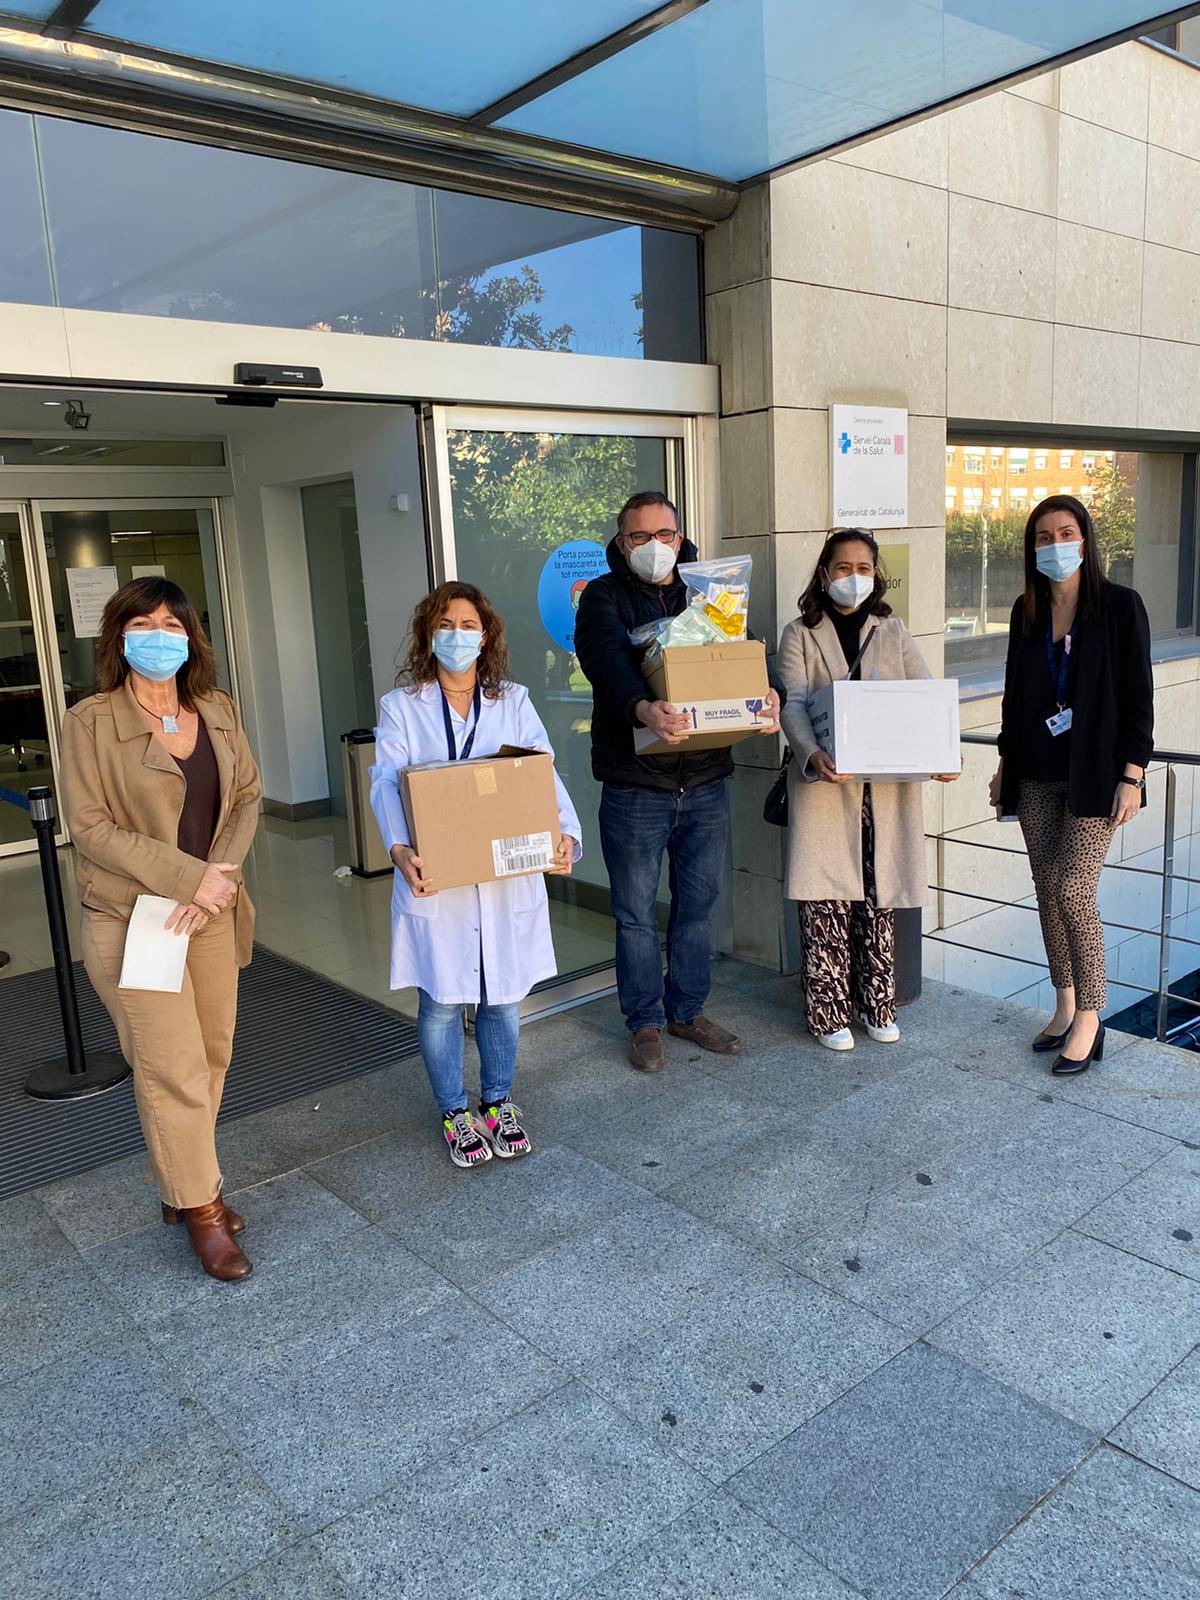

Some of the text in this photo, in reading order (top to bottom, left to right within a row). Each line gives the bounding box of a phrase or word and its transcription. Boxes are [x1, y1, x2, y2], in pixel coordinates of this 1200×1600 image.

[853, 435, 872, 445] Servei
[853, 446, 884, 455] de la Salut
[837, 507, 905, 517] Generalitat de Catalunya
[558, 550, 603, 559] Porta posada
[554, 561, 561, 569] la
[562, 560, 597, 569] mascareta
[561, 569, 600, 579] tot moment
